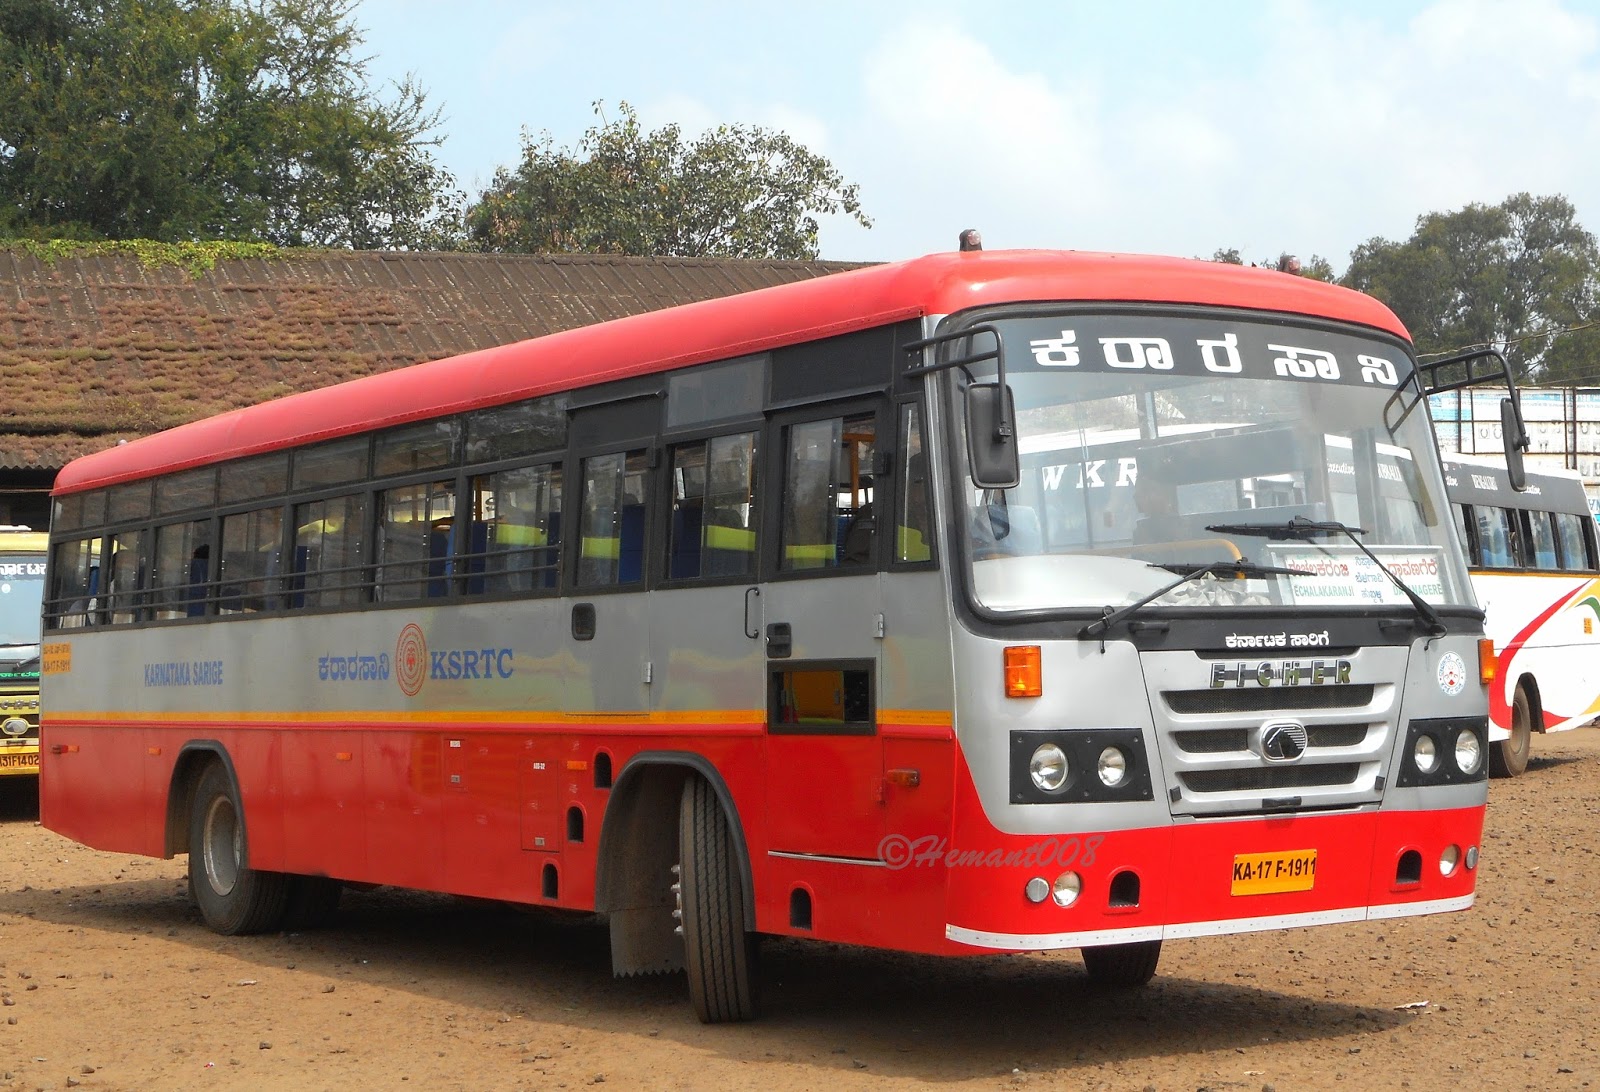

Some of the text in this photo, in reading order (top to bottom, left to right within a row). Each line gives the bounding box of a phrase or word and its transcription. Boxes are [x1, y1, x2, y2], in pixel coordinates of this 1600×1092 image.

[1393, 583, 1443, 596] DANAGERE
[1225, 630, 1330, 648] ಕರ್ನಾಟಕ ಸಾರಿಗೆ
[144, 660, 223, 688] KARNATAKA SARIGE
[318, 651, 390, 682] ಕರಾರಸಾನಿ
[430, 648, 514, 680] KSRTC
[1210, 659, 1352, 688] EICHER
[1233, 857, 1317, 881] KA-17 F-1911
